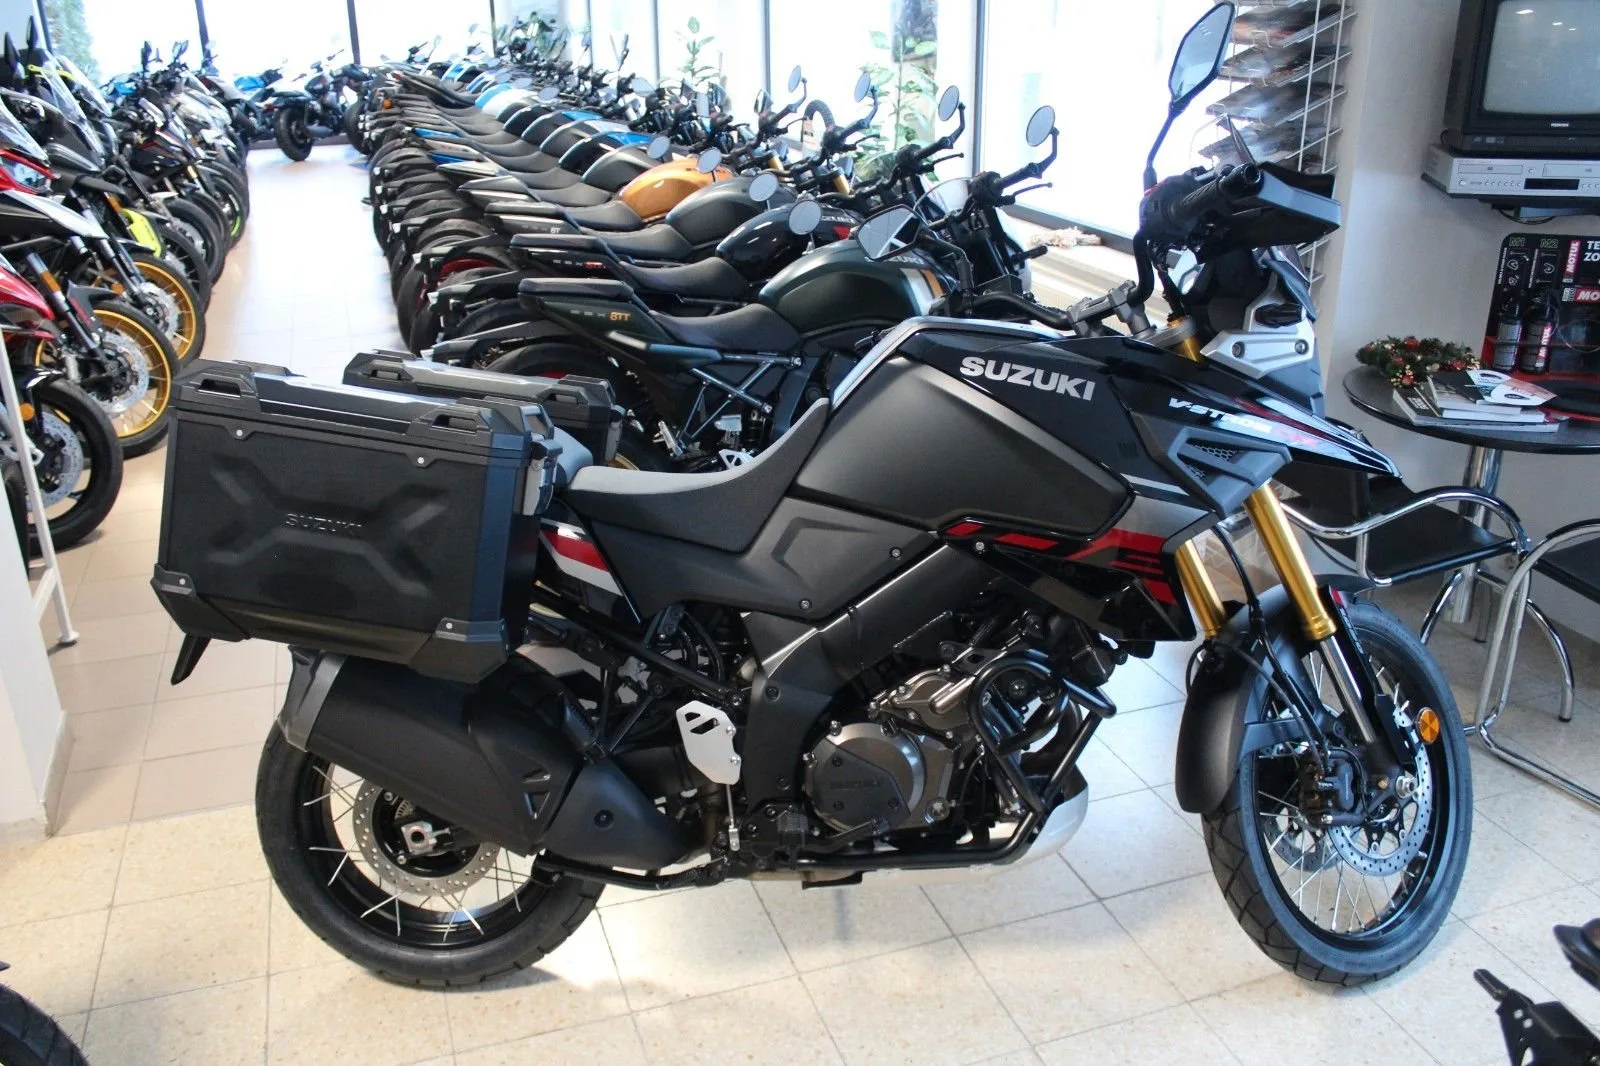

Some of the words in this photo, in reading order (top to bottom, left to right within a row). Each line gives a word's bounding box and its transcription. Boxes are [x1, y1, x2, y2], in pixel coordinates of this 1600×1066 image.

[1565, 241, 1579, 273] MOTUL
[960, 356, 1096, 401] SUZUKI
[286, 513, 362, 536] SUZUKI
